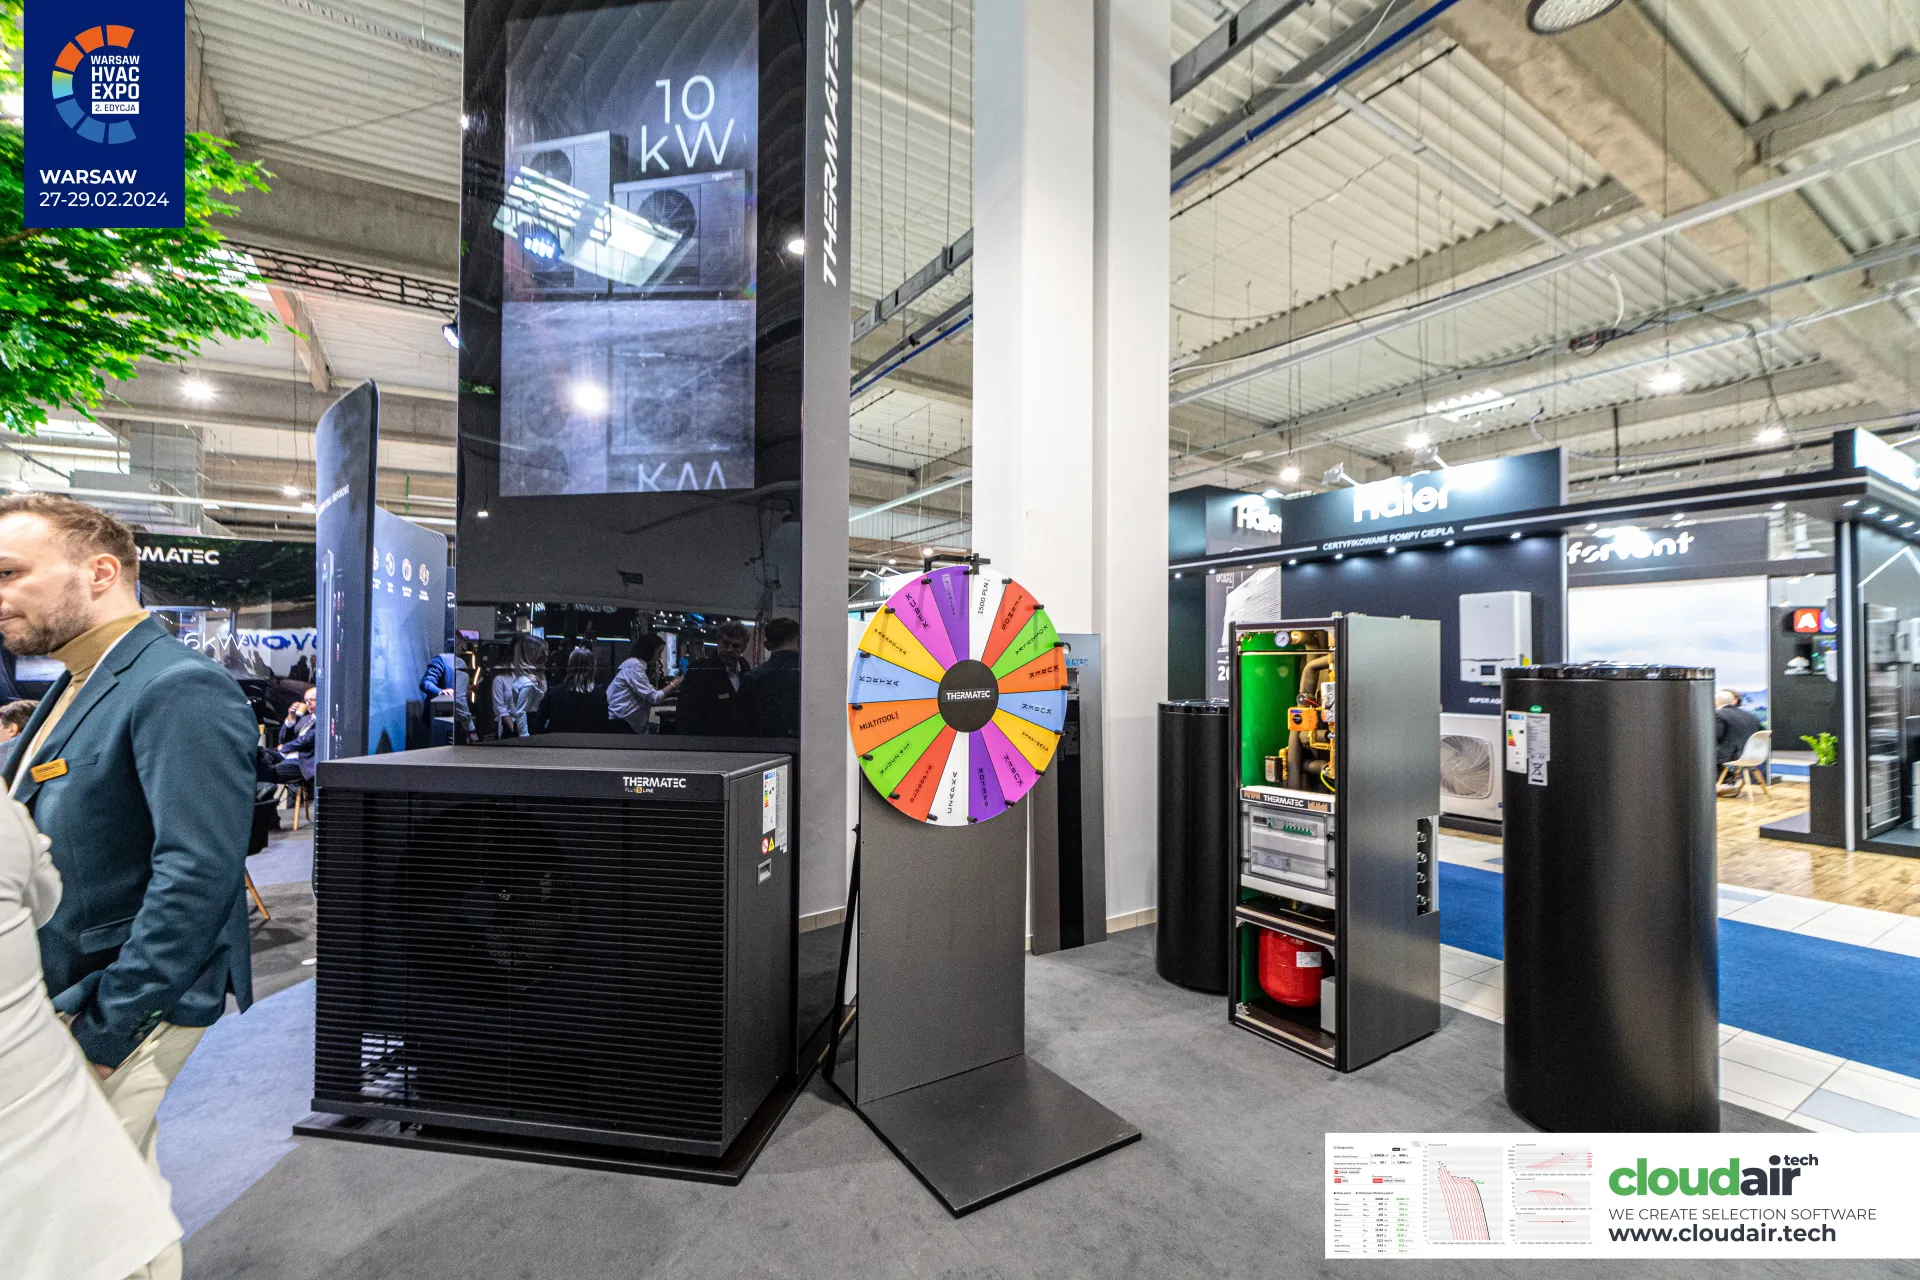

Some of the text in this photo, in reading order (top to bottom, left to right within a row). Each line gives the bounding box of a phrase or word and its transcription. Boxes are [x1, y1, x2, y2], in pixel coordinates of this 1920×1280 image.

[655, 75, 715, 124] 10
[641, 118, 735, 173] kW
[823, 0, 839, 287] THERMATEC
[1323, 534, 1389, 551] CERTYFIKOWANE
[1389, 530, 1421, 543] POMPY
[906, 593, 929, 629] KUBEK
[1002, 595, 1022, 631] TERMOS
[859, 675, 899, 687] KURTKA
[1029, 665, 1059, 678] KUBEK
[946, 690, 990, 701] THERMATEC
[1022, 703, 1052, 714] KUBEK
[623, 776, 687, 788] THERMATEC
[977, 767, 989, 807] BRELOK
[1004, 755, 1024, 787] KUBEK
[948, 771, 957, 813] CZAPKA
[1263, 794, 1304, 807] THERMATEC
